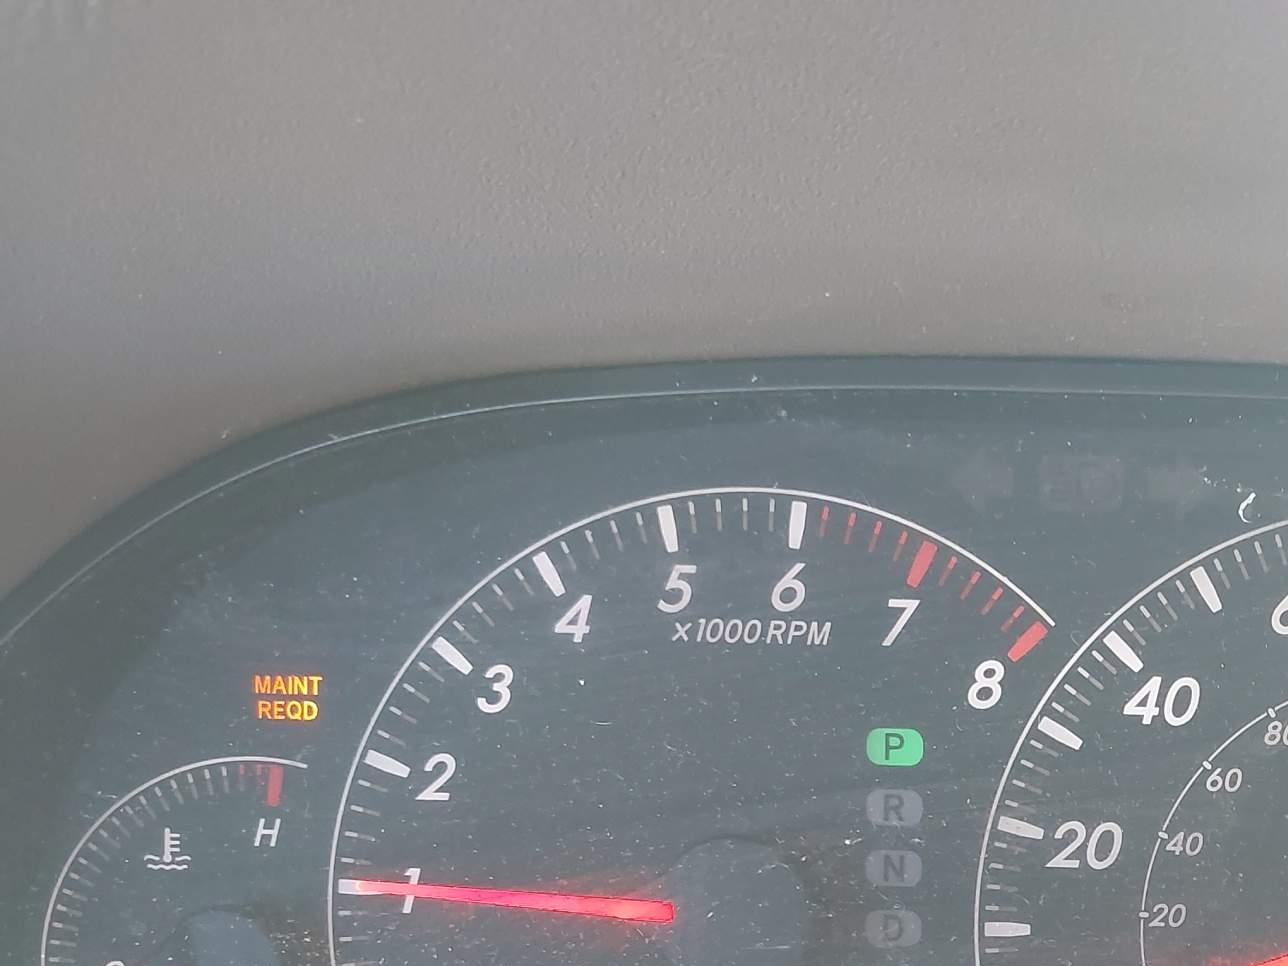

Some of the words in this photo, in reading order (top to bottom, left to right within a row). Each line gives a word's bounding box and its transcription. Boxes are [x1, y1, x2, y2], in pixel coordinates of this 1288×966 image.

[657, 564, 697, 613] 5
[770, 562, 806, 613] 6
[555, 594, 592, 643] 4
[765, 620, 832, 646] RPM
[881, 598, 921, 646] 7
[254, 675, 323, 696] MAINT
[476, 664, 514, 713] 3
[967, 659, 1005, 710] 8
[1123, 676, 1200, 727] 40
[257, 700, 319, 720] REQD
[883, 732, 906, 761] P
[415, 753, 457, 801] 2
[1205, 768, 1243, 793] 60
[882, 793, 906, 822] R
[254, 818, 282, 847] H
[1045, 821, 1123, 871] 20
[1165, 832, 1204, 857] 40
[882, 854, 906, 883] N
[402, 867, 421, 914] 1
[1149, 903, 1187, 928] 20
